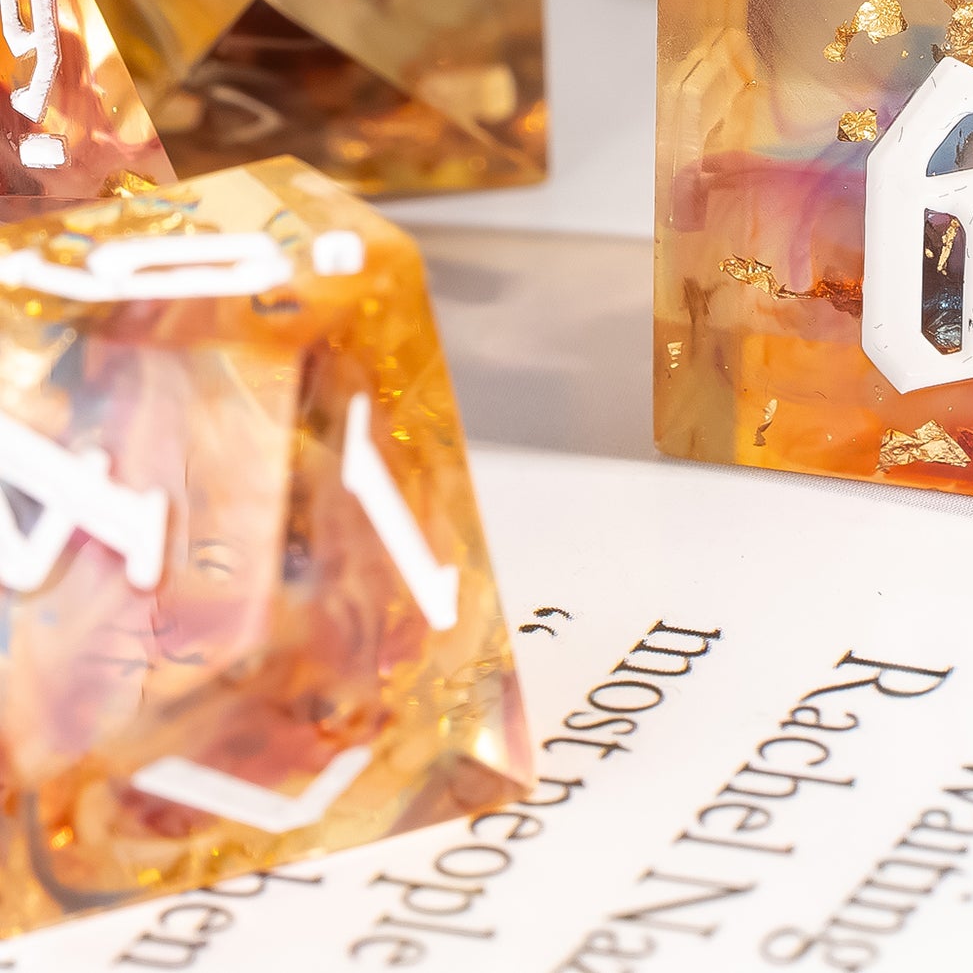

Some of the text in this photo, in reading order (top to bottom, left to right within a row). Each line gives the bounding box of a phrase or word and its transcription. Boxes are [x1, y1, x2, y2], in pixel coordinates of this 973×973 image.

[0, 407, 168, 593] 4
[342, 390, 459, 631] 1
[542, 619, 721, 759] most
[671, 649, 956, 856] Rachel
